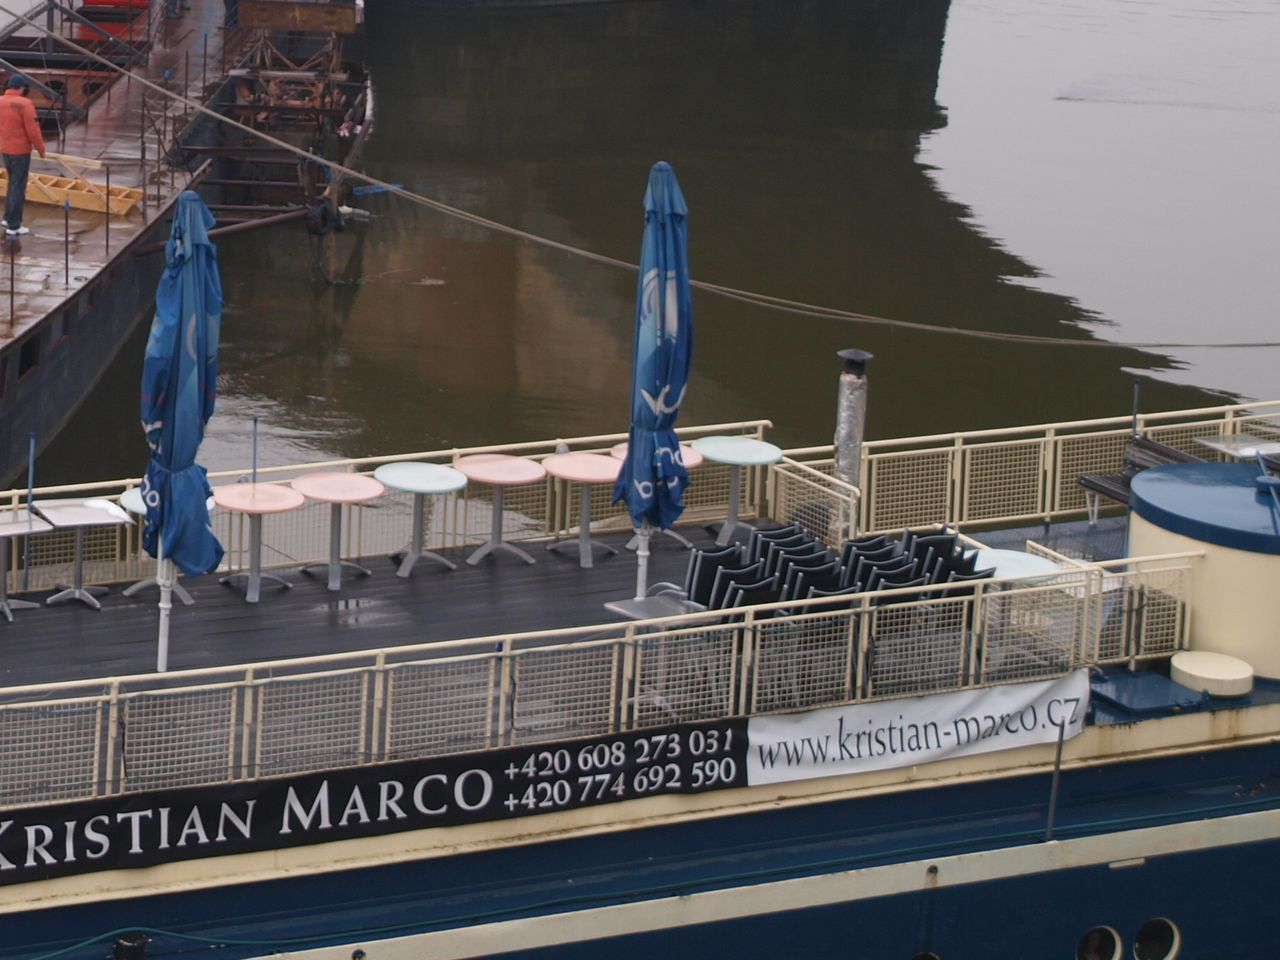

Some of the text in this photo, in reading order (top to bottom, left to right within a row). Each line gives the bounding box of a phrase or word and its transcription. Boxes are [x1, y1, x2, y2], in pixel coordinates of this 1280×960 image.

[504, 728, 732, 780] +420 608 273 031
[757, 696, 1081, 770] www.kristian-marco.cz
[279, 769, 494, 834] MARCO
[504, 757, 737, 811] +420 774 692 590
